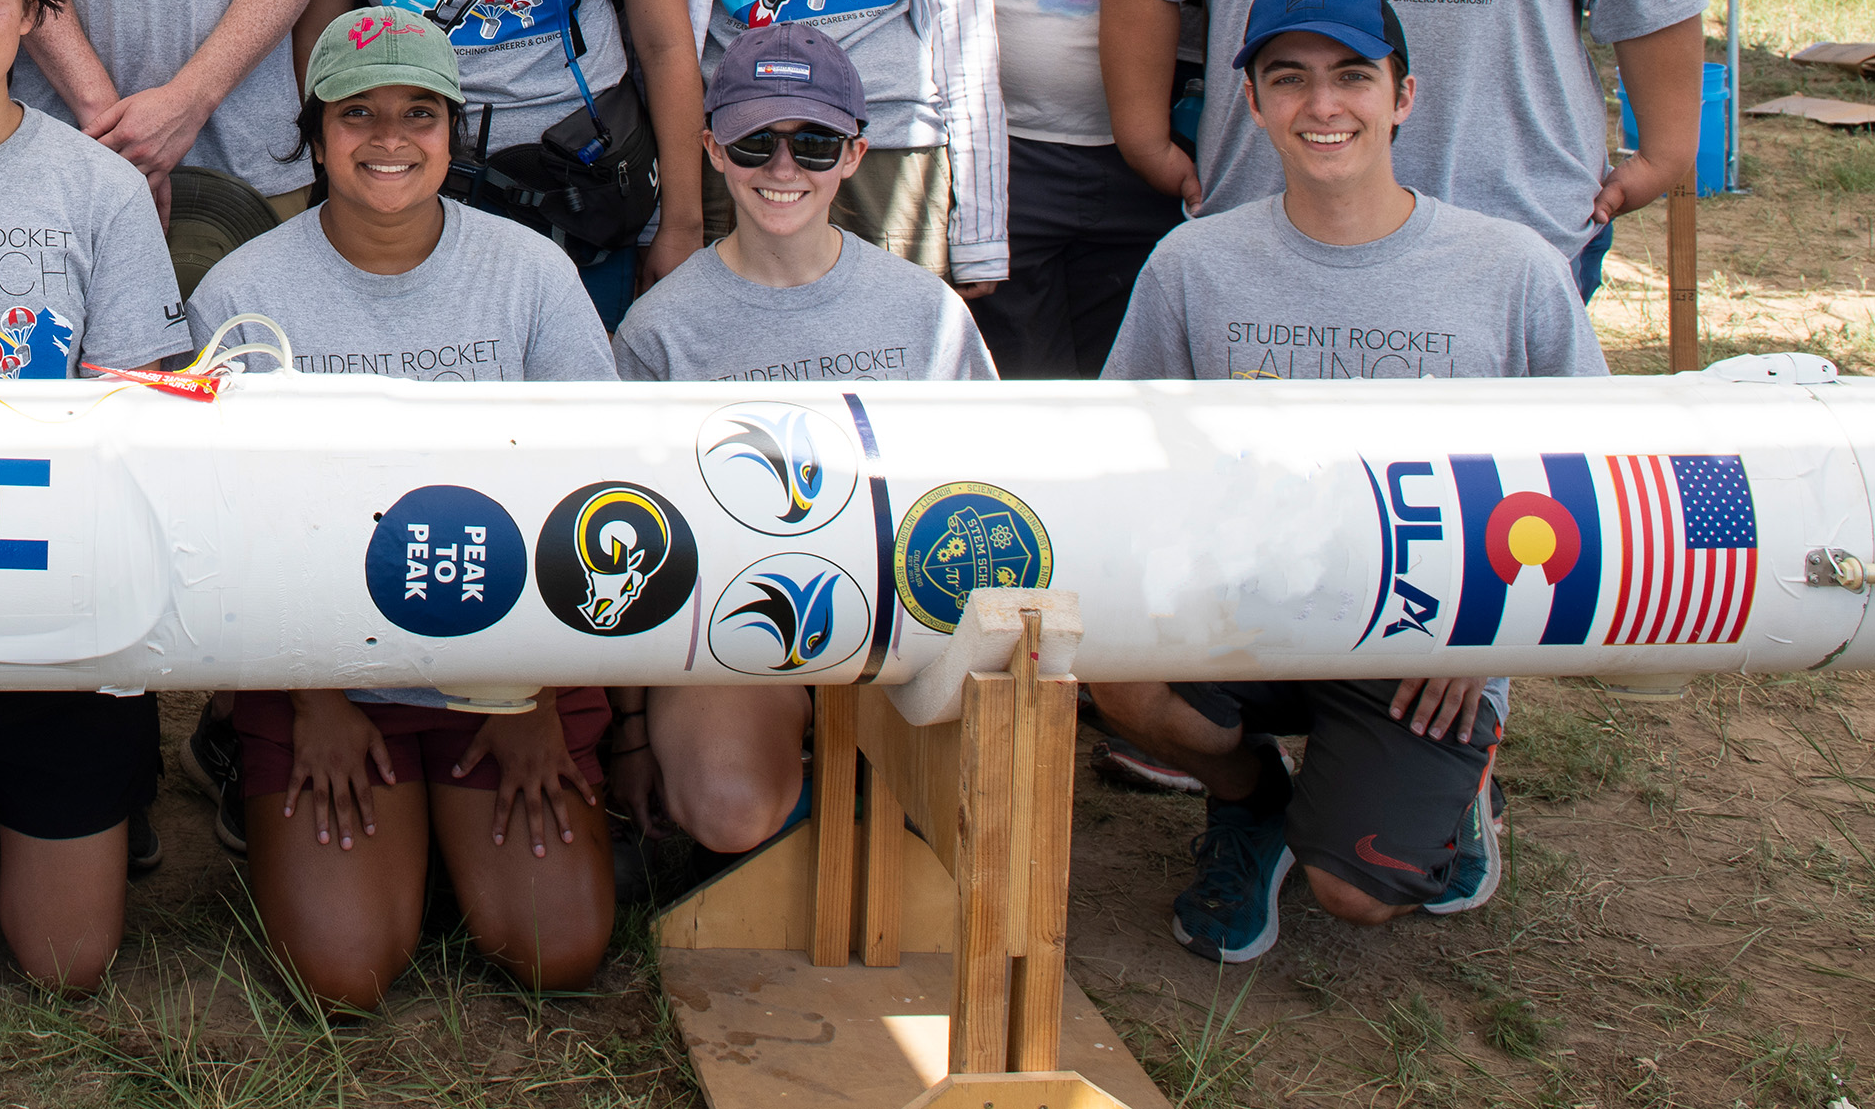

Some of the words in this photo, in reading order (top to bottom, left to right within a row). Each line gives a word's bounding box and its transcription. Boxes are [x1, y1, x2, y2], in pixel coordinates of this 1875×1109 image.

[820, 12, 858, 26] CAREERS
[453, 47, 487, 56] NCHING
[488, 40, 526, 52] CAREERS
[536, 32, 562, 45] CURIO
[295, 352, 393, 374] TUDENT
[401, 338, 500, 372] ROCKET
[1227, 321, 1341, 348] STUDENT
[1349, 327, 1456, 354] ROCKET
[819, 346, 907, 378] ROCKET
[919, 486, 952, 510] HONESTY
[899, 513, 918, 556] INTEGRITY
[967, 483, 1004, 499] SCIENCE
[1014, 502, 1049, 551] TECHNOLOGY
[404, 523, 430, 601] PEAK
[434, 543, 457, 583] TO
[461, 525, 487, 603] PEAK
[913, 549, 924, 588] COLORADO
[967, 518, 986, 554] STEM
[977, 558, 988, 589] SCHO
[1383, 461, 1443, 639] ULA
[896, 565, 911, 599] RESPECT
[910, 604, 957, 632] RESPONSIBIL
